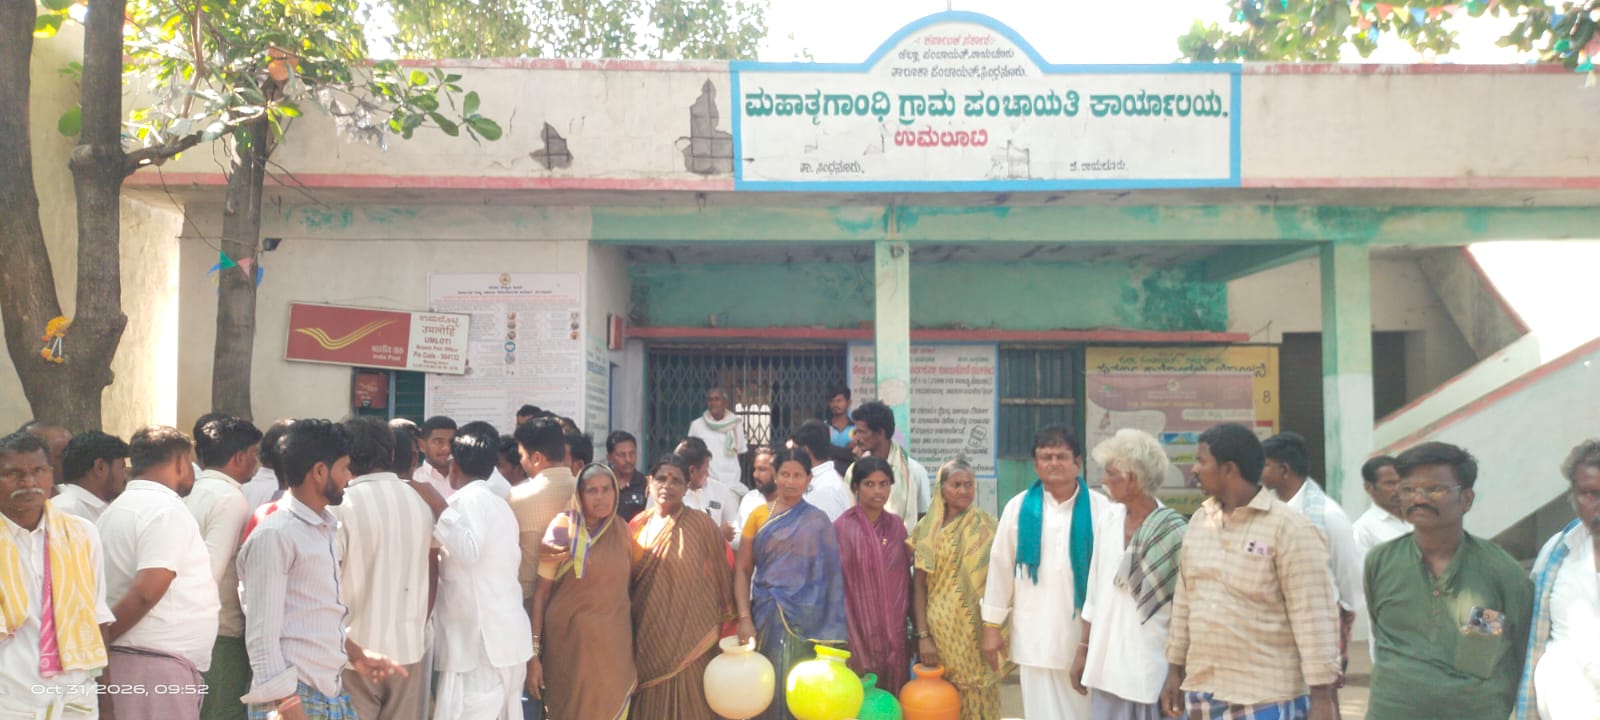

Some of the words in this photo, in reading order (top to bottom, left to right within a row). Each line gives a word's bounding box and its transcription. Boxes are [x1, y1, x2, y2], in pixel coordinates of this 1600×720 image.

[898, 88, 956, 125] ಗ್ರಾಮ
[963, 88, 1080, 118] ಪಂಚಾಯತಿ
[424, 336, 451, 345] UMLOTI
